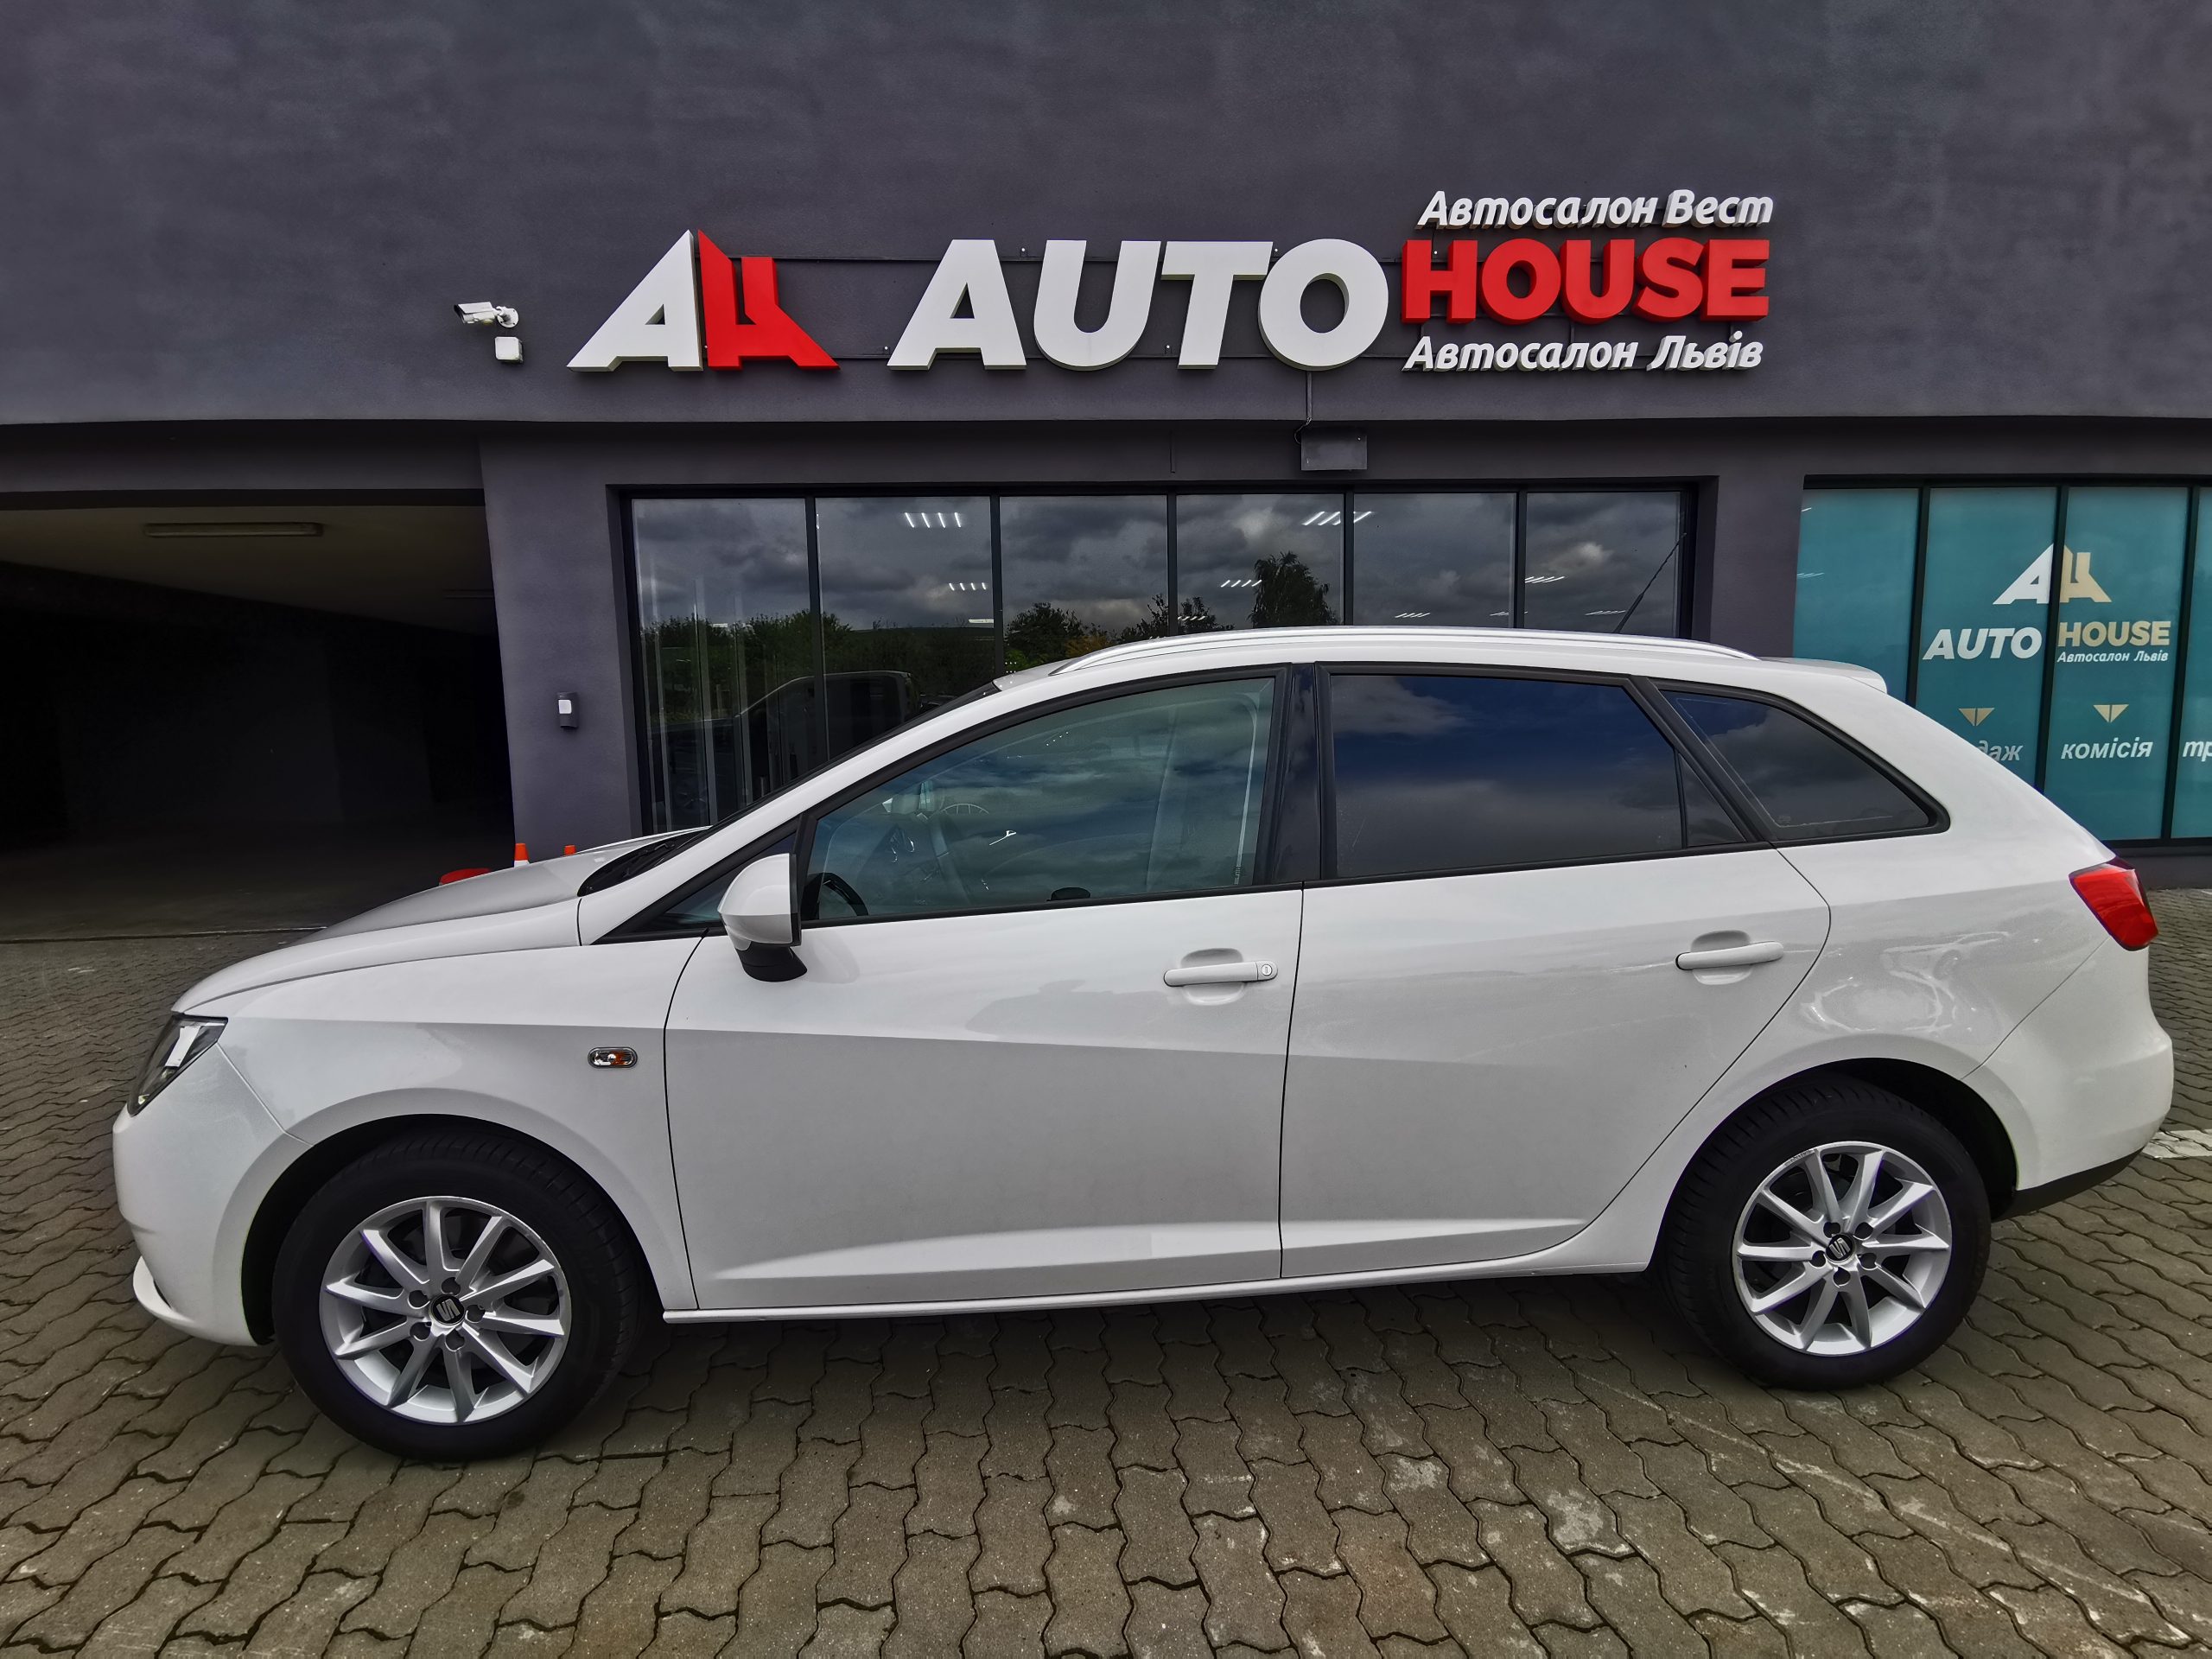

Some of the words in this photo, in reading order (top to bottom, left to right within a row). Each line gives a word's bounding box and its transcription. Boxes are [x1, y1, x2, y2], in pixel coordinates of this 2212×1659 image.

[1415, 190, 1658, 230] Автосалон
[1663, 188, 1774, 228] Вест
[887, 238, 1389, 371] AUTO
[1401, 237, 1770, 324] HOUSE
[1402, 335, 1638, 372] Автосалон
[1645, 330, 1764, 372] Львів
[1923, 626, 2043, 660] AUTO
[2057, 620, 2171, 647] HOUSE
[2056, 651, 2130, 663] Автосалон
[2133, 649, 2169, 662] Львів
[2061, 736, 2153, 760] комісія
[2182, 741, 2212, 762] тр
